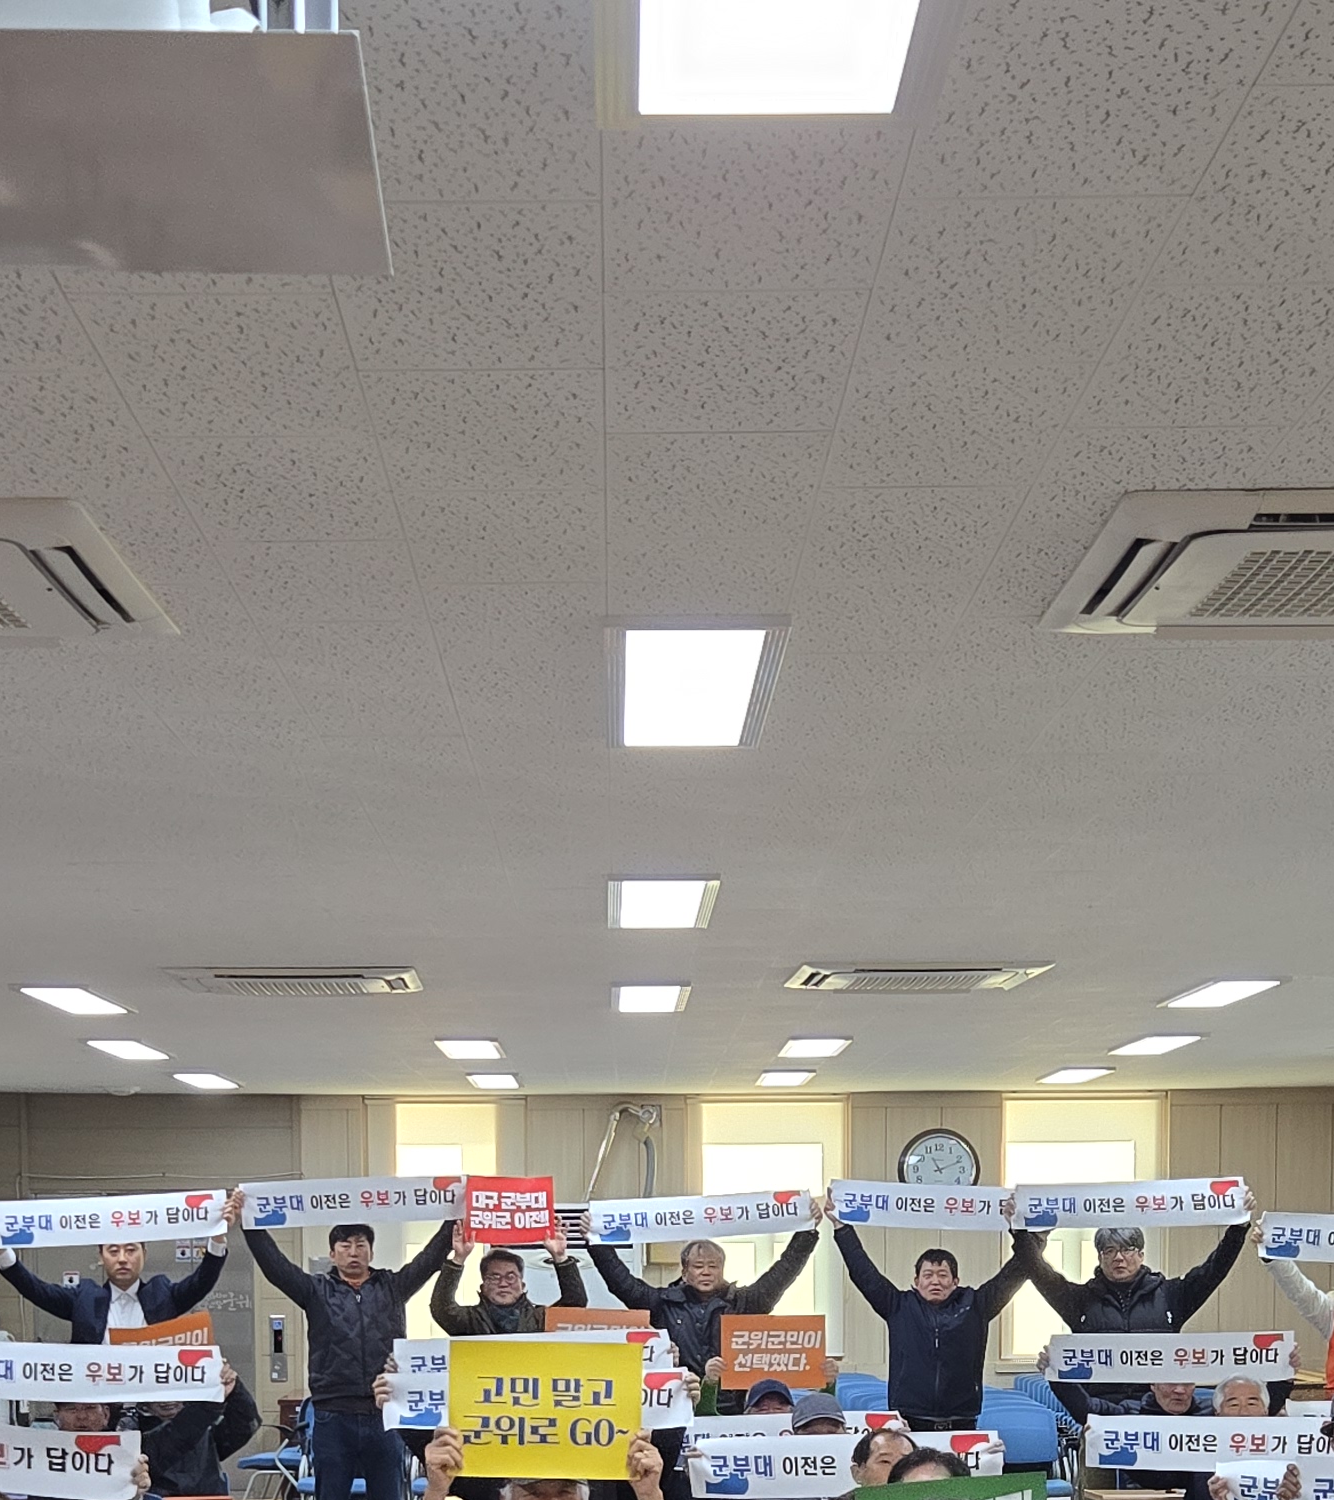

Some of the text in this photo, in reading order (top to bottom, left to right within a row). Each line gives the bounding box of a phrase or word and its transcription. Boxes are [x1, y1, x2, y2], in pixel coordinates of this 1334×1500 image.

[256, 1195, 304, 1214] 군부대
[310, 1193, 351, 1210] 이전은
[414, 1189, 455, 1205] 답이다
[471, 1191, 547, 1209] 대구 군부대
[844, 1193, 889, 1210] 군부대
[896, 1197, 935, 1213] 이전은
[1028, 1197, 1076, 1214] 군부대
[1083, 1198, 1125, 1214] 이전은
[1191, 1193, 1236, 1211] 답이다
[4, 1214, 53, 1232] 군부대
[59, 1213, 101, 1229] 이전은
[166, 1206, 209, 1224] 답이다
[470, 1210, 511, 1229] 군위군
[602, 1212, 648, 1230] 군부대
[654, 1209, 695, 1226] 이전은
[756, 1202, 798, 1220] 답이다
[1271, 1226, 1320, 1247] 군부대
[731, 1330, 821, 1349] 군위군민이
[733, 1353, 810, 1372] 선택했다.
[1062, 1349, 1113, 1367] 군부대
[1120, 1350, 1163, 1367] 이전은
[1233, 1347, 1279, 1364] 답이다
[22, 1362, 73, 1382] 이전은
[154, 1363, 206, 1384] 답이다
[474, 1376, 616, 1408] 고민 말고
[461, 1415, 560, 1446] 군위로
[1103, 1431, 1160, 1451] 군부대
[1168, 1434, 1217, 1452] 이전은
[1297, 1434, 1330, 1454] 답이
[46, 1448, 115, 1475] 답이다
[710, 1455, 837, 1477] 군부대 이전은
